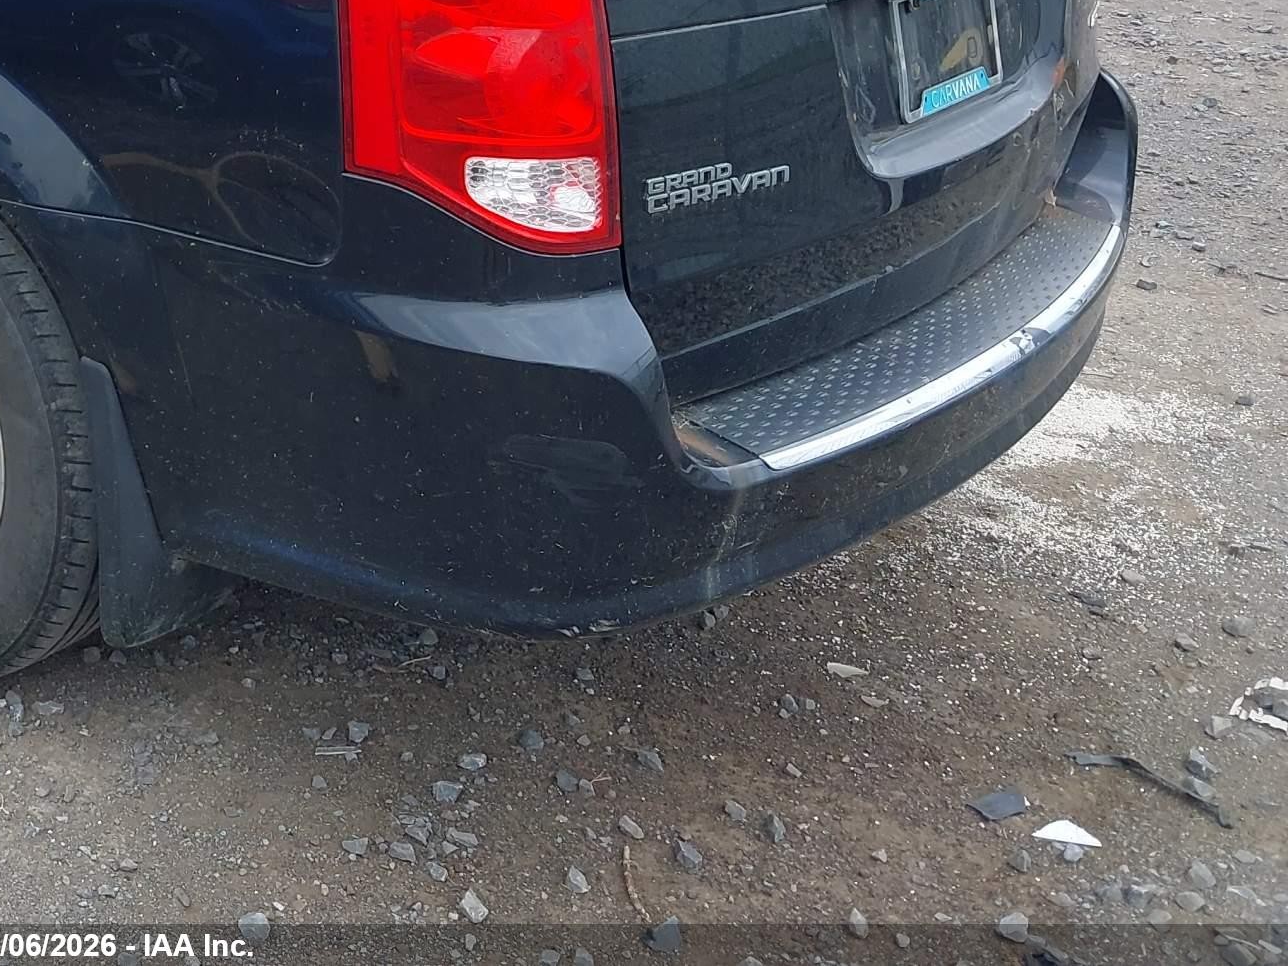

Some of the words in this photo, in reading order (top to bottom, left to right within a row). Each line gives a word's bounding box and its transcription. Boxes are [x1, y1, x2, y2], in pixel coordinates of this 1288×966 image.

[931, 73, 982, 108] CARVANA
[646, 162, 733, 195] GRAND
[646, 165, 790, 214] CARAVAN
